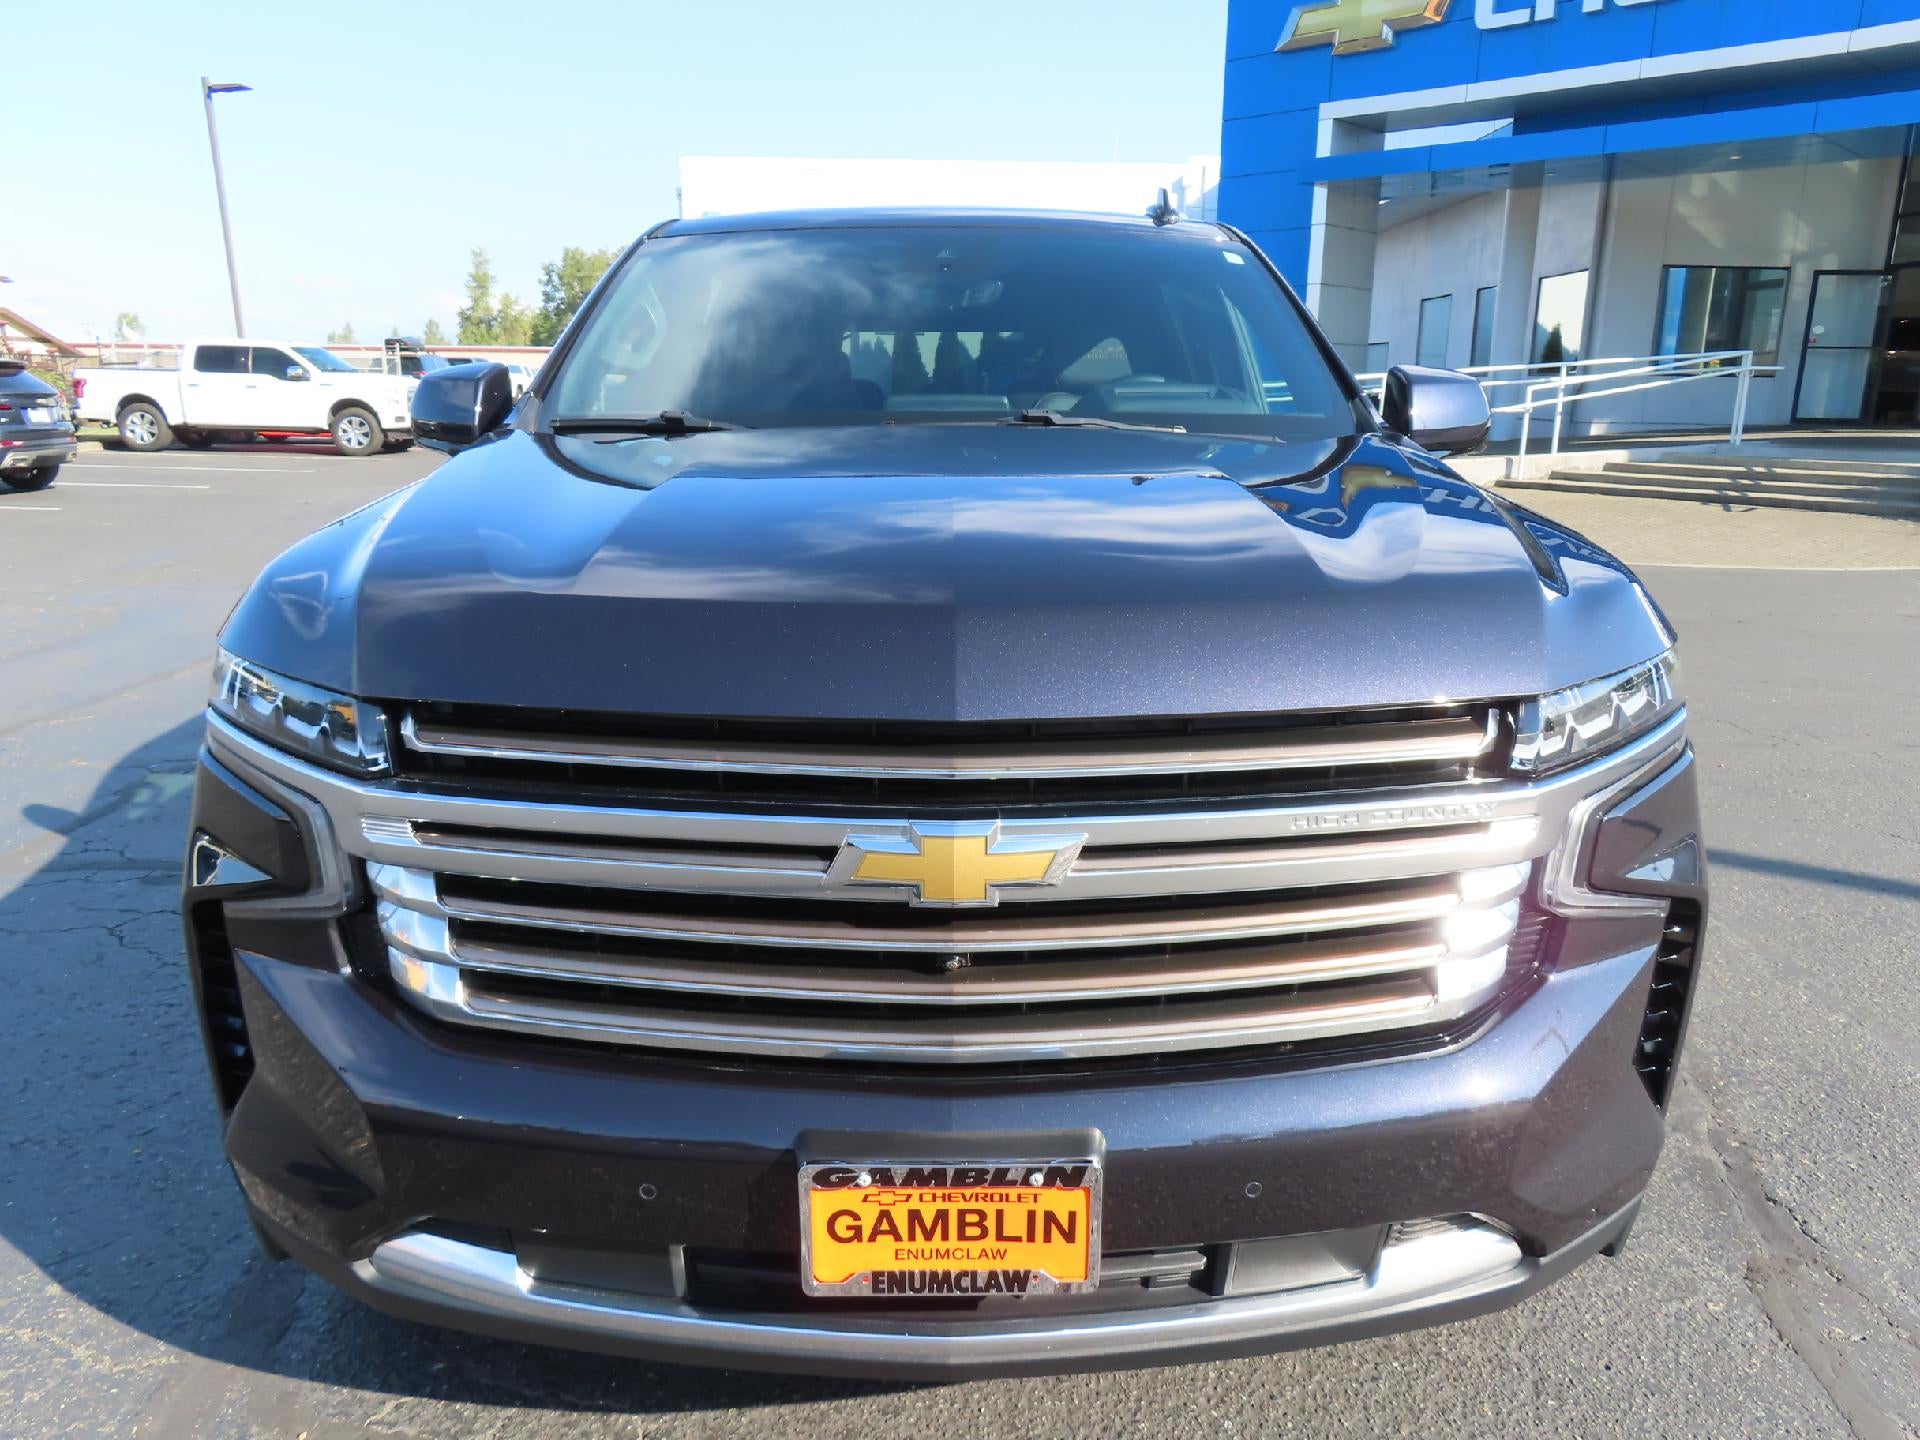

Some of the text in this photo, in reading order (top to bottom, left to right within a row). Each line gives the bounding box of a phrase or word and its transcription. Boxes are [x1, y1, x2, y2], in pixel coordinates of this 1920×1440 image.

[1371, 801, 1497, 824] COUNTRY
[811, 1167, 1089, 1188] GAMBLIN
[918, 1192, 1042, 1204] CHEVROLET
[826, 1209, 1077, 1244] GAMBLIN
[894, 1247, 1008, 1261] ENUMCLAW
[870, 1269, 1032, 1294] ENUMCLAW
